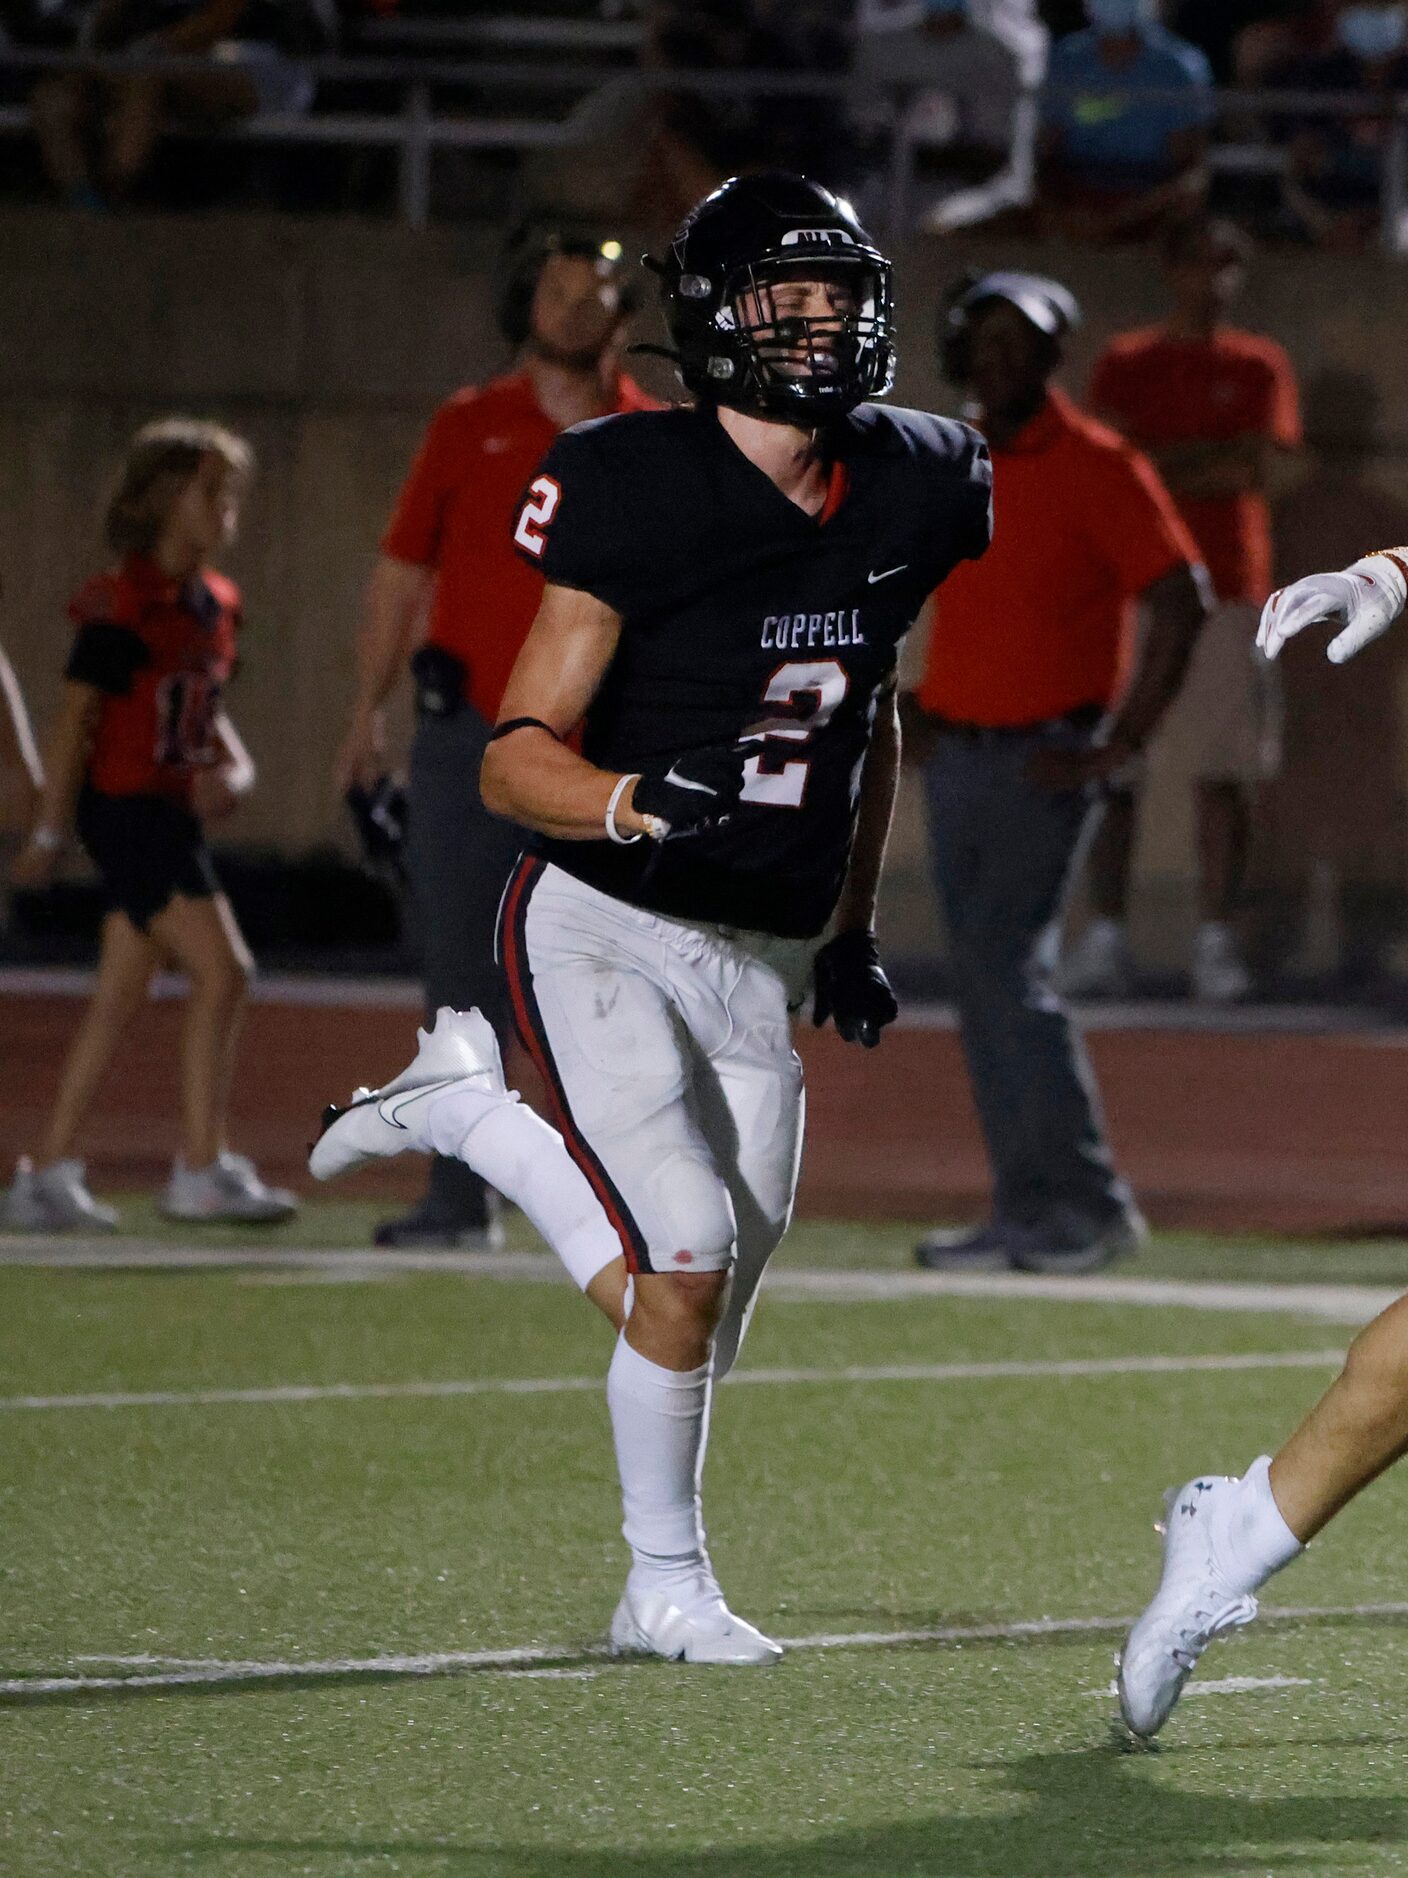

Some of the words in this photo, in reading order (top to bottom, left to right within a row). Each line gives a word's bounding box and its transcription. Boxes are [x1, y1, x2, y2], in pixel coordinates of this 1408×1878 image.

[513, 474, 561, 559] 2
[761, 609, 866, 649] COPPELL
[738, 656, 850, 810] 2
